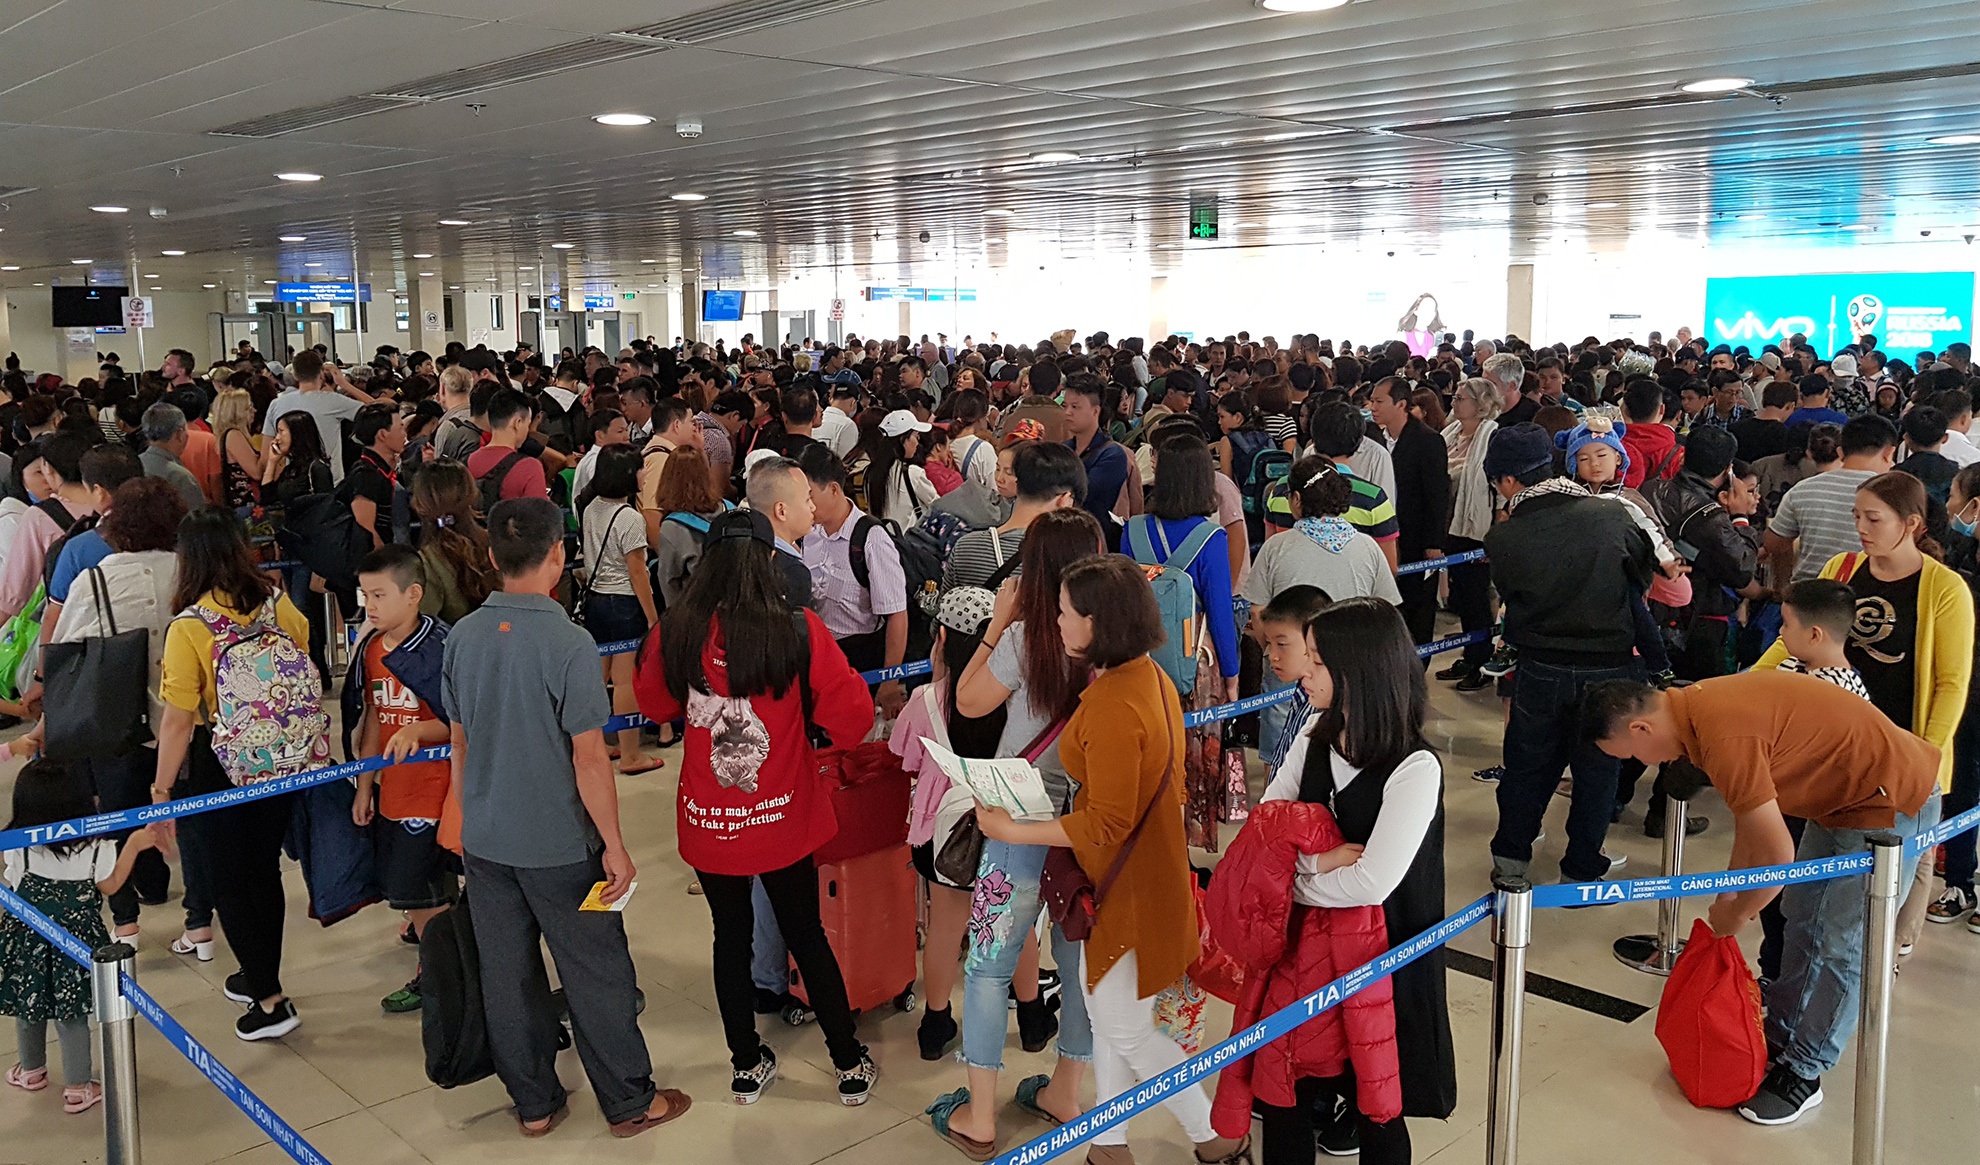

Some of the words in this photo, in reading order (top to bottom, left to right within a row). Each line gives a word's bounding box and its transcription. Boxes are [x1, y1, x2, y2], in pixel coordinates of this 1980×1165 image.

[1885, 315, 1962, 331] RUSSIA
[879, 667, 905, 680] TIA
[1240, 702, 1252, 710] TAN
[1252, 697, 1263, 707] SON
[1263, 693, 1278, 704] NHAT
[1191, 710, 1214, 724] TIA
[206, 790, 245, 805] KHÔNG
[247, 782, 278, 797] QUỐC
[279, 777, 293, 790] TẾ
[294, 775, 314, 786] TÂN
[316, 770, 338, 781] SƠN
[340, 762, 366, 776] NHẤT
[710, 807, 722, 816] to
[701, 818, 724, 829] fake
[728, 812, 785, 832] perfection.
[24, 823, 78, 843] TIA
[1915, 829, 1935, 850] TIA
[1681, 876, 1713, 891] CẢNG
[1715, 873, 1746, 888] HÀNG
[1748, 869, 1786, 884] KHÔNG
[1789, 864, 1819, 879] QUỐC
[1822, 858, 1835, 873] TẾ
[1837, 857, 1858, 871] TÂN
[1577, 884, 1625, 902] TIA
[1633, 885, 1672, 893] INTERNATIONAL
[1380, 956, 1396, 972] TAN
[1397, 946, 1415, 963] SON
[1415, 932, 1437, 953] NHAT
[1304, 985, 1340, 1016] TIA
[184, 1035, 211, 1076] TIA
[1009, 1142, 1048, 1165] CẢNG
[1051, 1123, 1088, 1151] HÀNG
[1090, 1097, 1134, 1131] KHÔNG
[1136, 1073, 1171, 1105] QUỐC
[1173, 1065, 1188, 1087] TẾ
[1190, 1057, 1212, 1079] TÂN
[1214, 1041, 1237, 1064] SƠN
[1239, 1025, 1268, 1052] NHẤT
[239, 1089, 254, 1113] TAN
[255, 1103, 272, 1129] SON
[272, 1118, 295, 1149] NHAT
